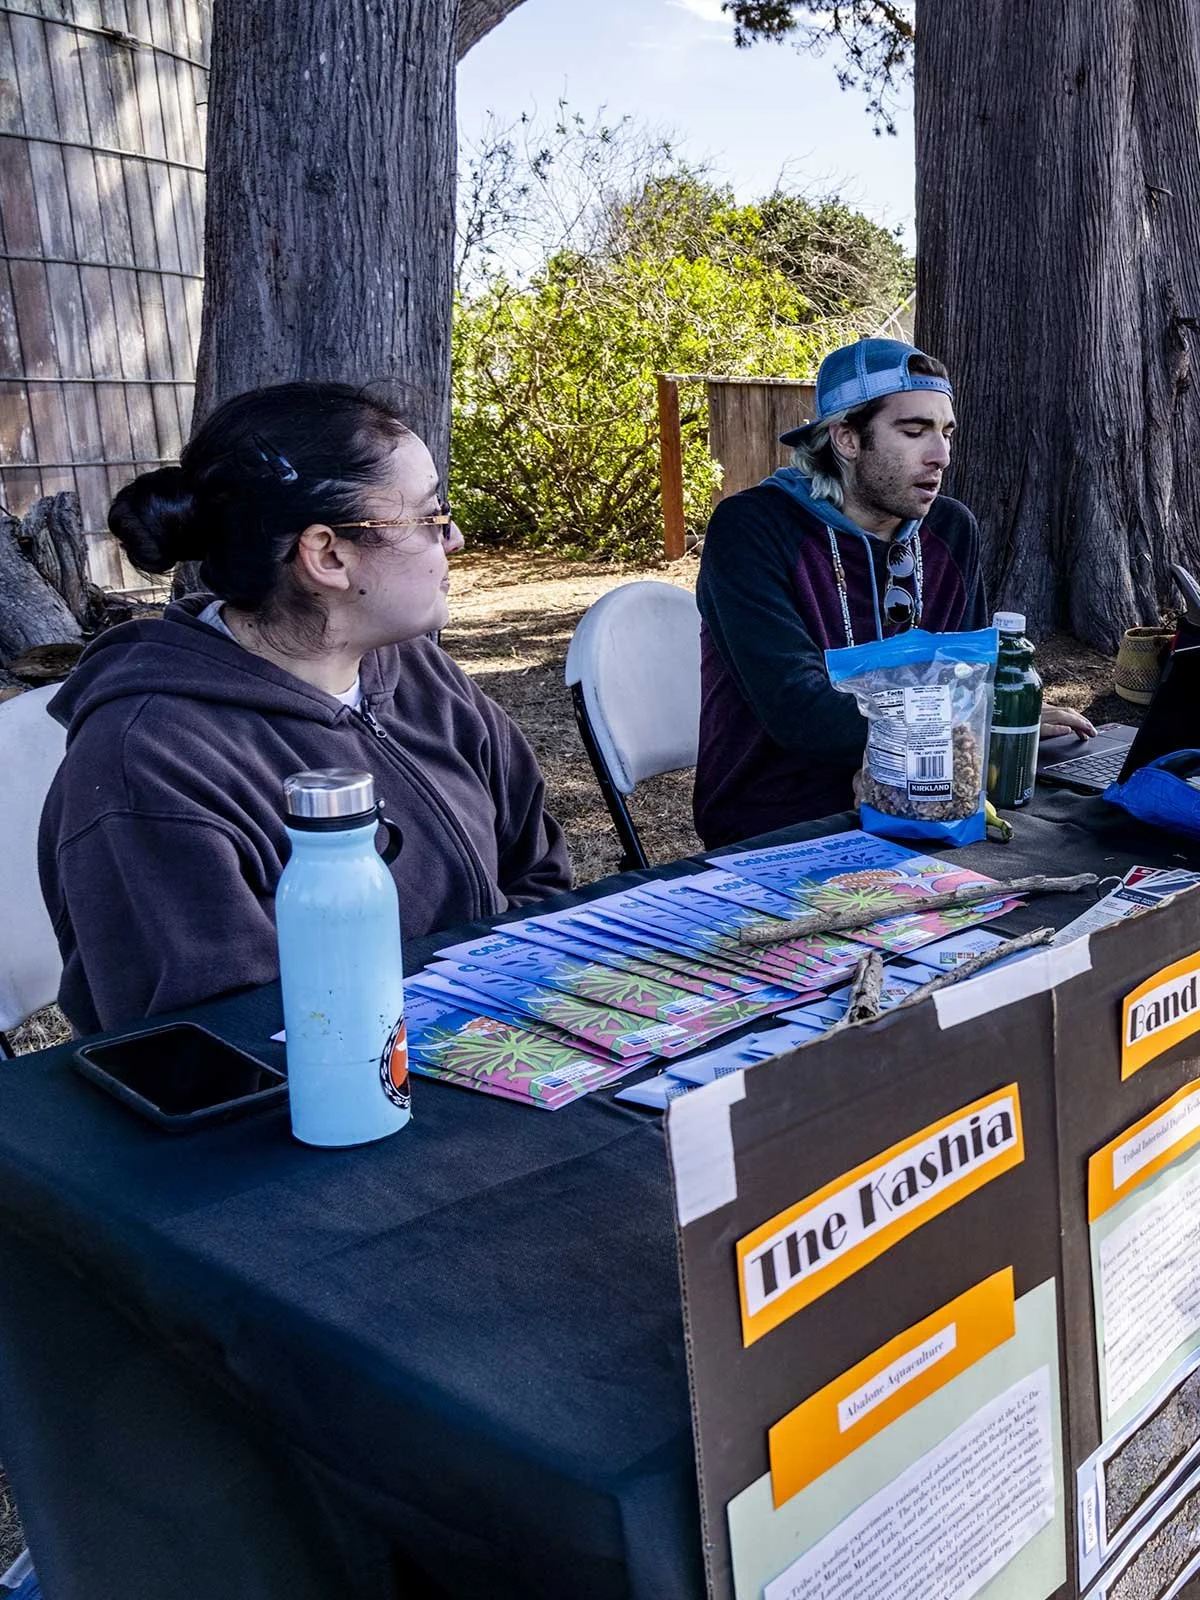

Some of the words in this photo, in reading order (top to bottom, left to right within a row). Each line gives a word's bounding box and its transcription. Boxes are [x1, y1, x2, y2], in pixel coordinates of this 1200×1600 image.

[912, 784, 950, 792] KIRKLAND
[733, 846, 823, 867] COLORING
[822, 836, 874, 851] BOOK
[1130, 977, 1198, 1042] Band
[750, 1212, 848, 1298] The
[858, 1110, 1013, 1229] Kashia
[845, 1376, 886, 1420] Abalone
[886, 1340, 946, 1386] Aquaculture
[824, 1555, 849, 1582] Marine
[854, 1545, 879, 1572] Marine
[903, 1514, 915, 1529] and
